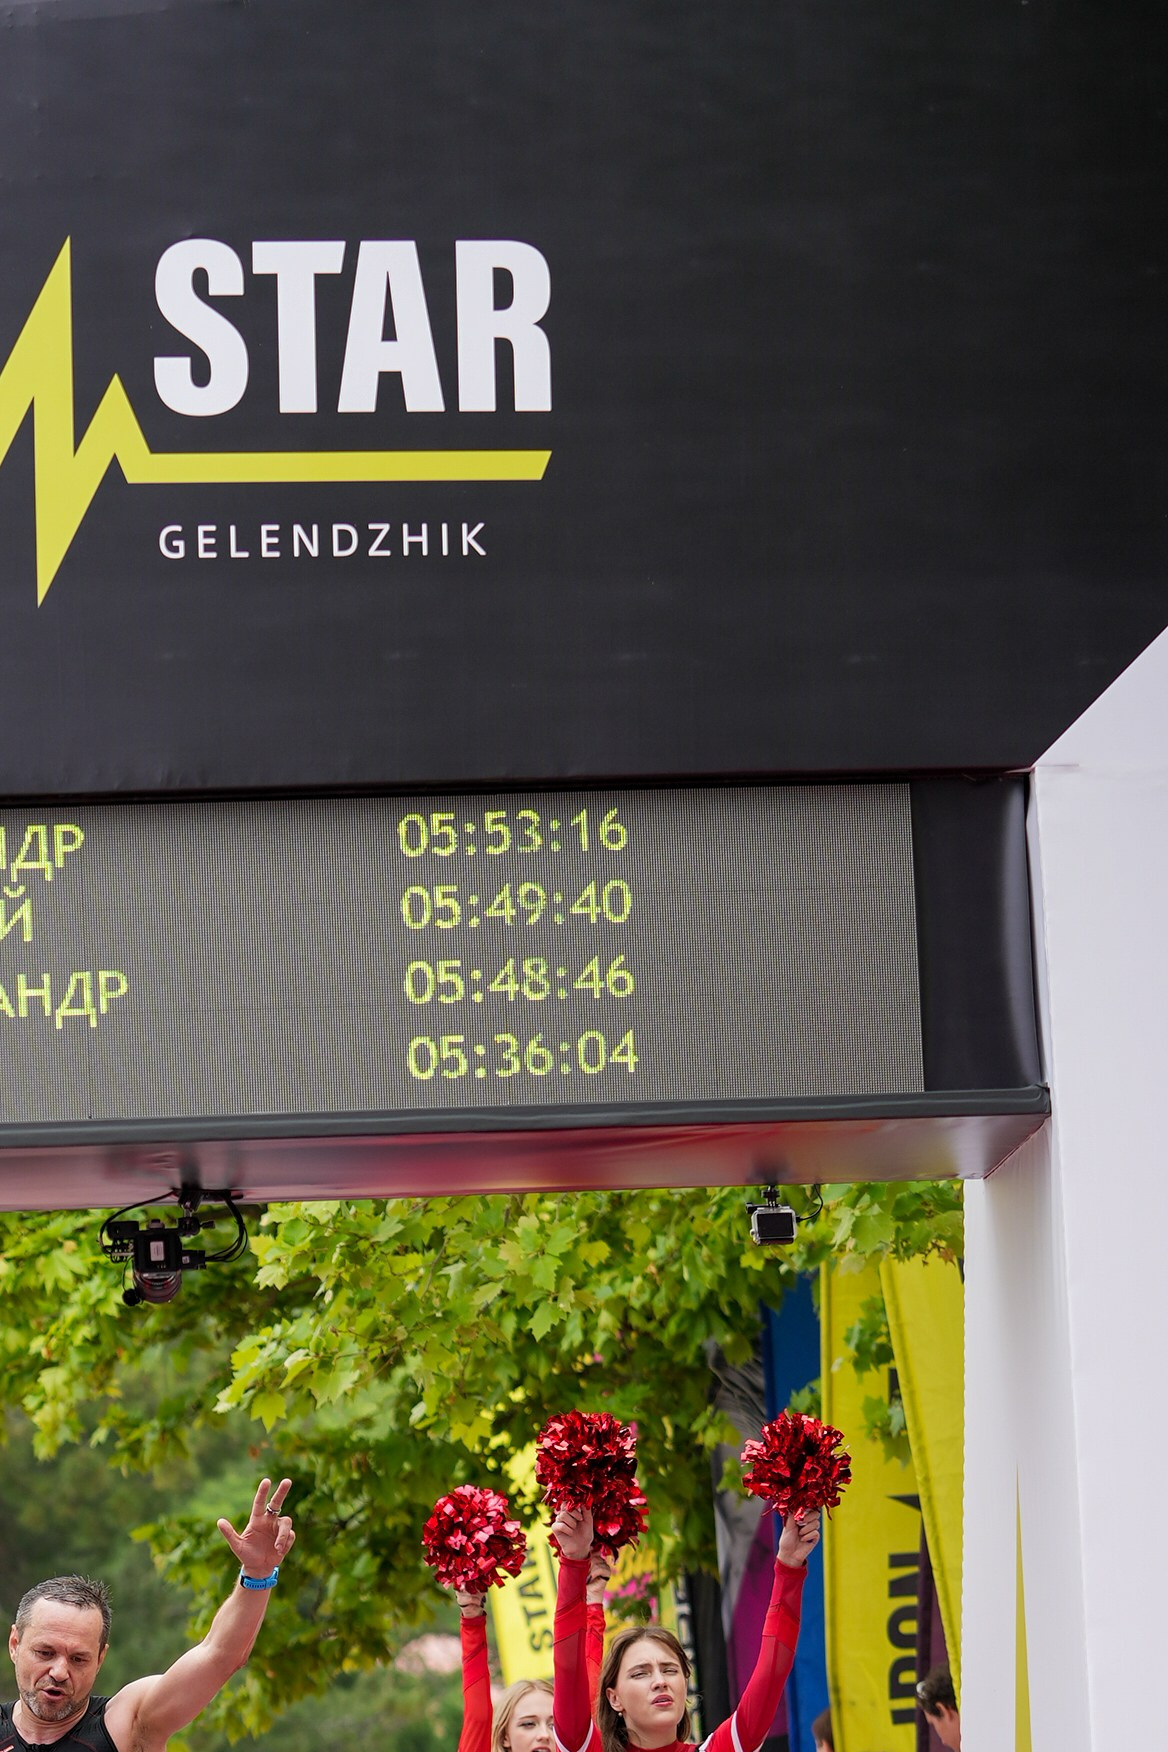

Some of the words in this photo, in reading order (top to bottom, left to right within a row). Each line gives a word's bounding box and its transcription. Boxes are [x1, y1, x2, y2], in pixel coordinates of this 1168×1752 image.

[153, 238, 552, 416] STAR
[159, 522, 488, 560] GELENDZHIK
[397, 808, 628, 857] 05:53:16
[401, 879, 632, 929] 05:49:40
[404, 955, 635, 1004] 05:48:46
[407, 1030, 639, 1080] 05:36:04
